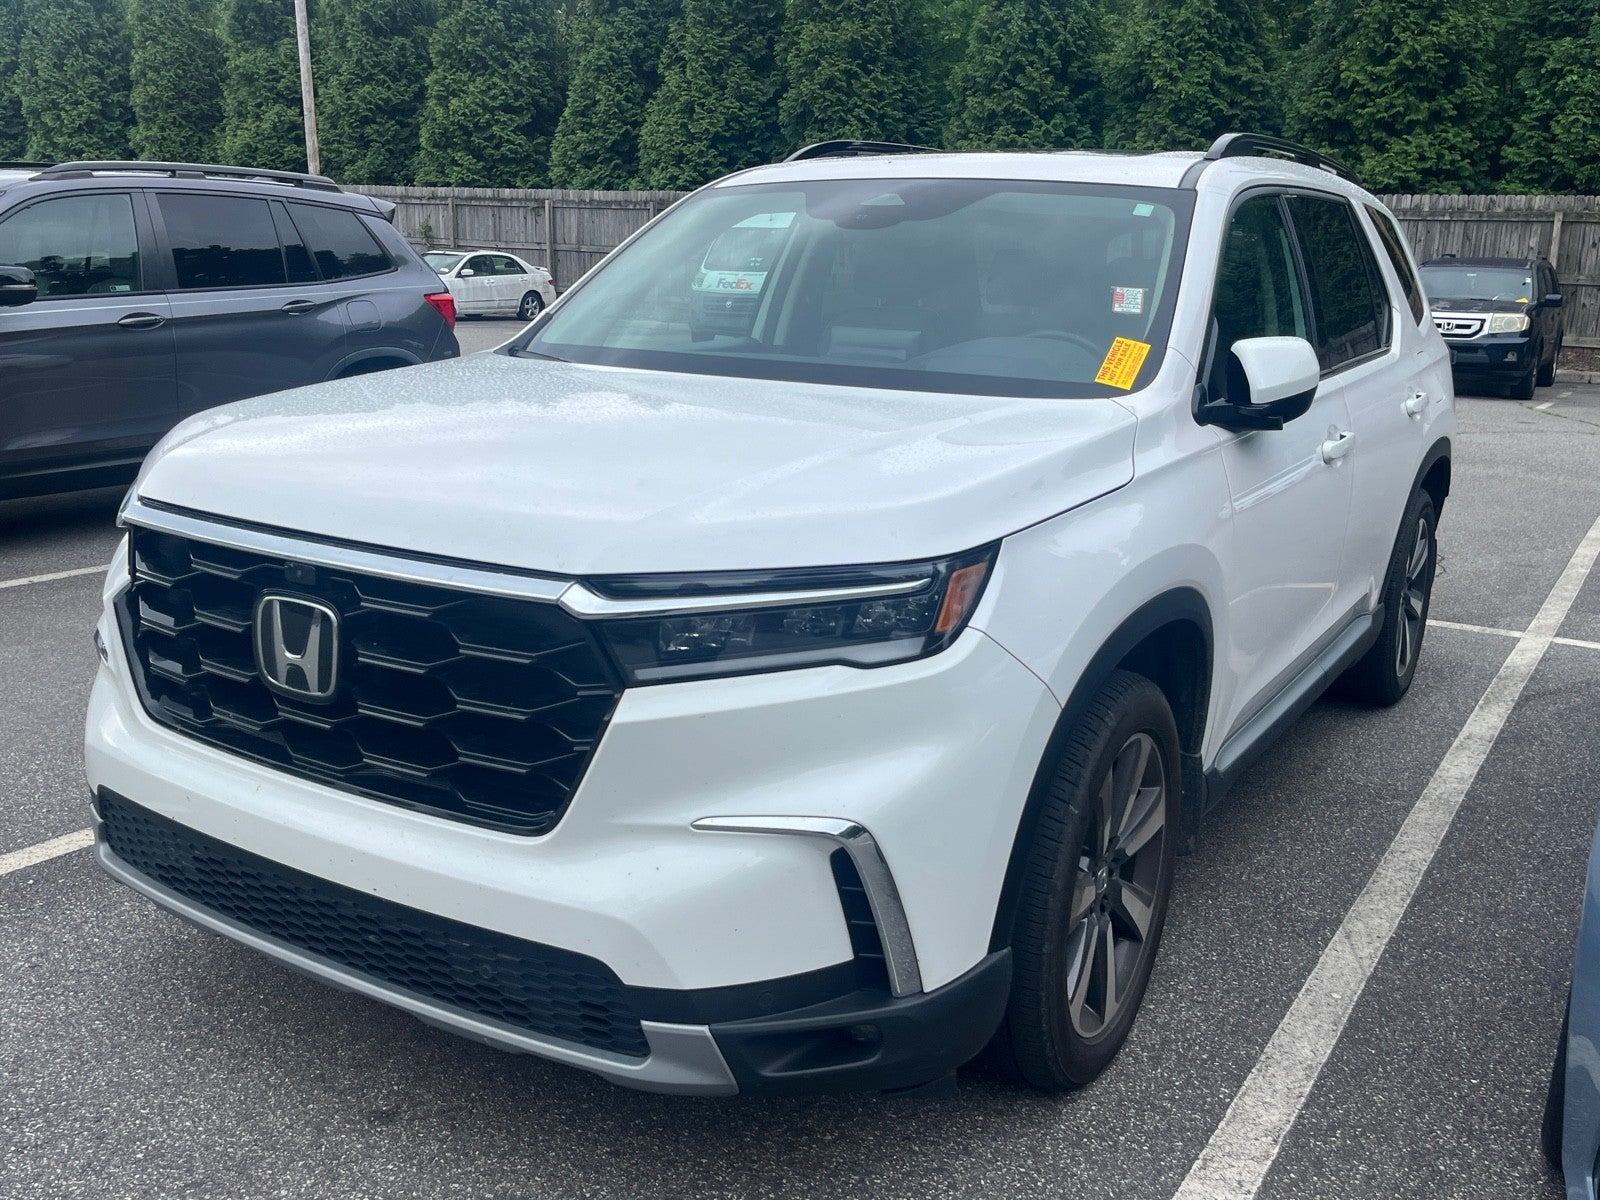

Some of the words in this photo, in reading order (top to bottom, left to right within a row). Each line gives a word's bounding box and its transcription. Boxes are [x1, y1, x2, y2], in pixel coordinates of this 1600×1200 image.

[716, 278, 753, 290] FedEx
[1097, 366, 1111, 380] THIS
[1105, 339, 1124, 365] VEHICLE
[1108, 369, 1118, 382] NOT
[1114, 357, 1123, 370] FOR
[1120, 343, 1131, 357] SALE
